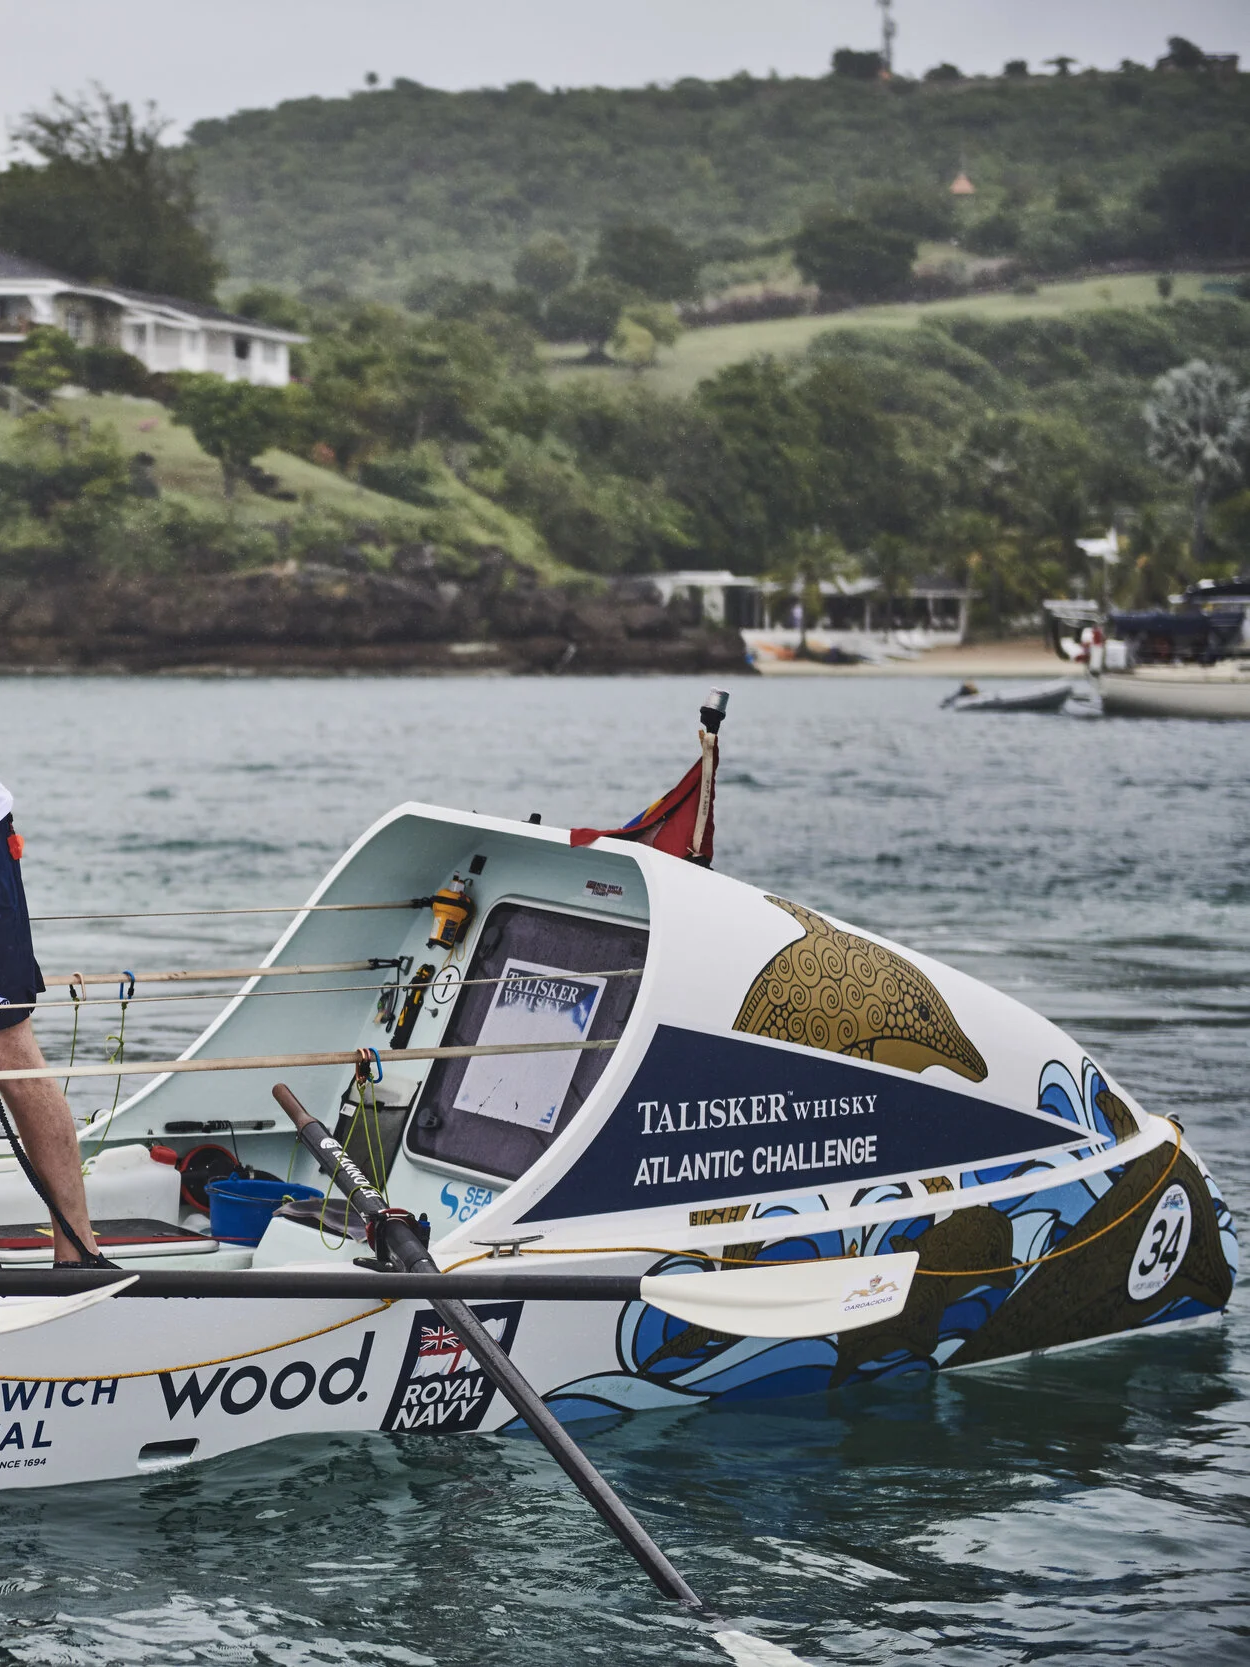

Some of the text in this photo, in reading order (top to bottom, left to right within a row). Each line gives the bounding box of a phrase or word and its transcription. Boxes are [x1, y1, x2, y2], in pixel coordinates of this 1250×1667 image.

[507, 971, 579, 1003] TALISKER
[637, 1093, 878, 1135] TALISKER WHISKY
[633, 1134, 878, 1187] ATLANTIC CHALLENGE
[464, 1186, 493, 1208] SEA
[1138, 1215, 1185, 1277] 34
[401, 1376, 484, 1407] ROYAL
[391, 1398, 482, 1431] NAVY
[23, 1458, 47, 1467] 1694
